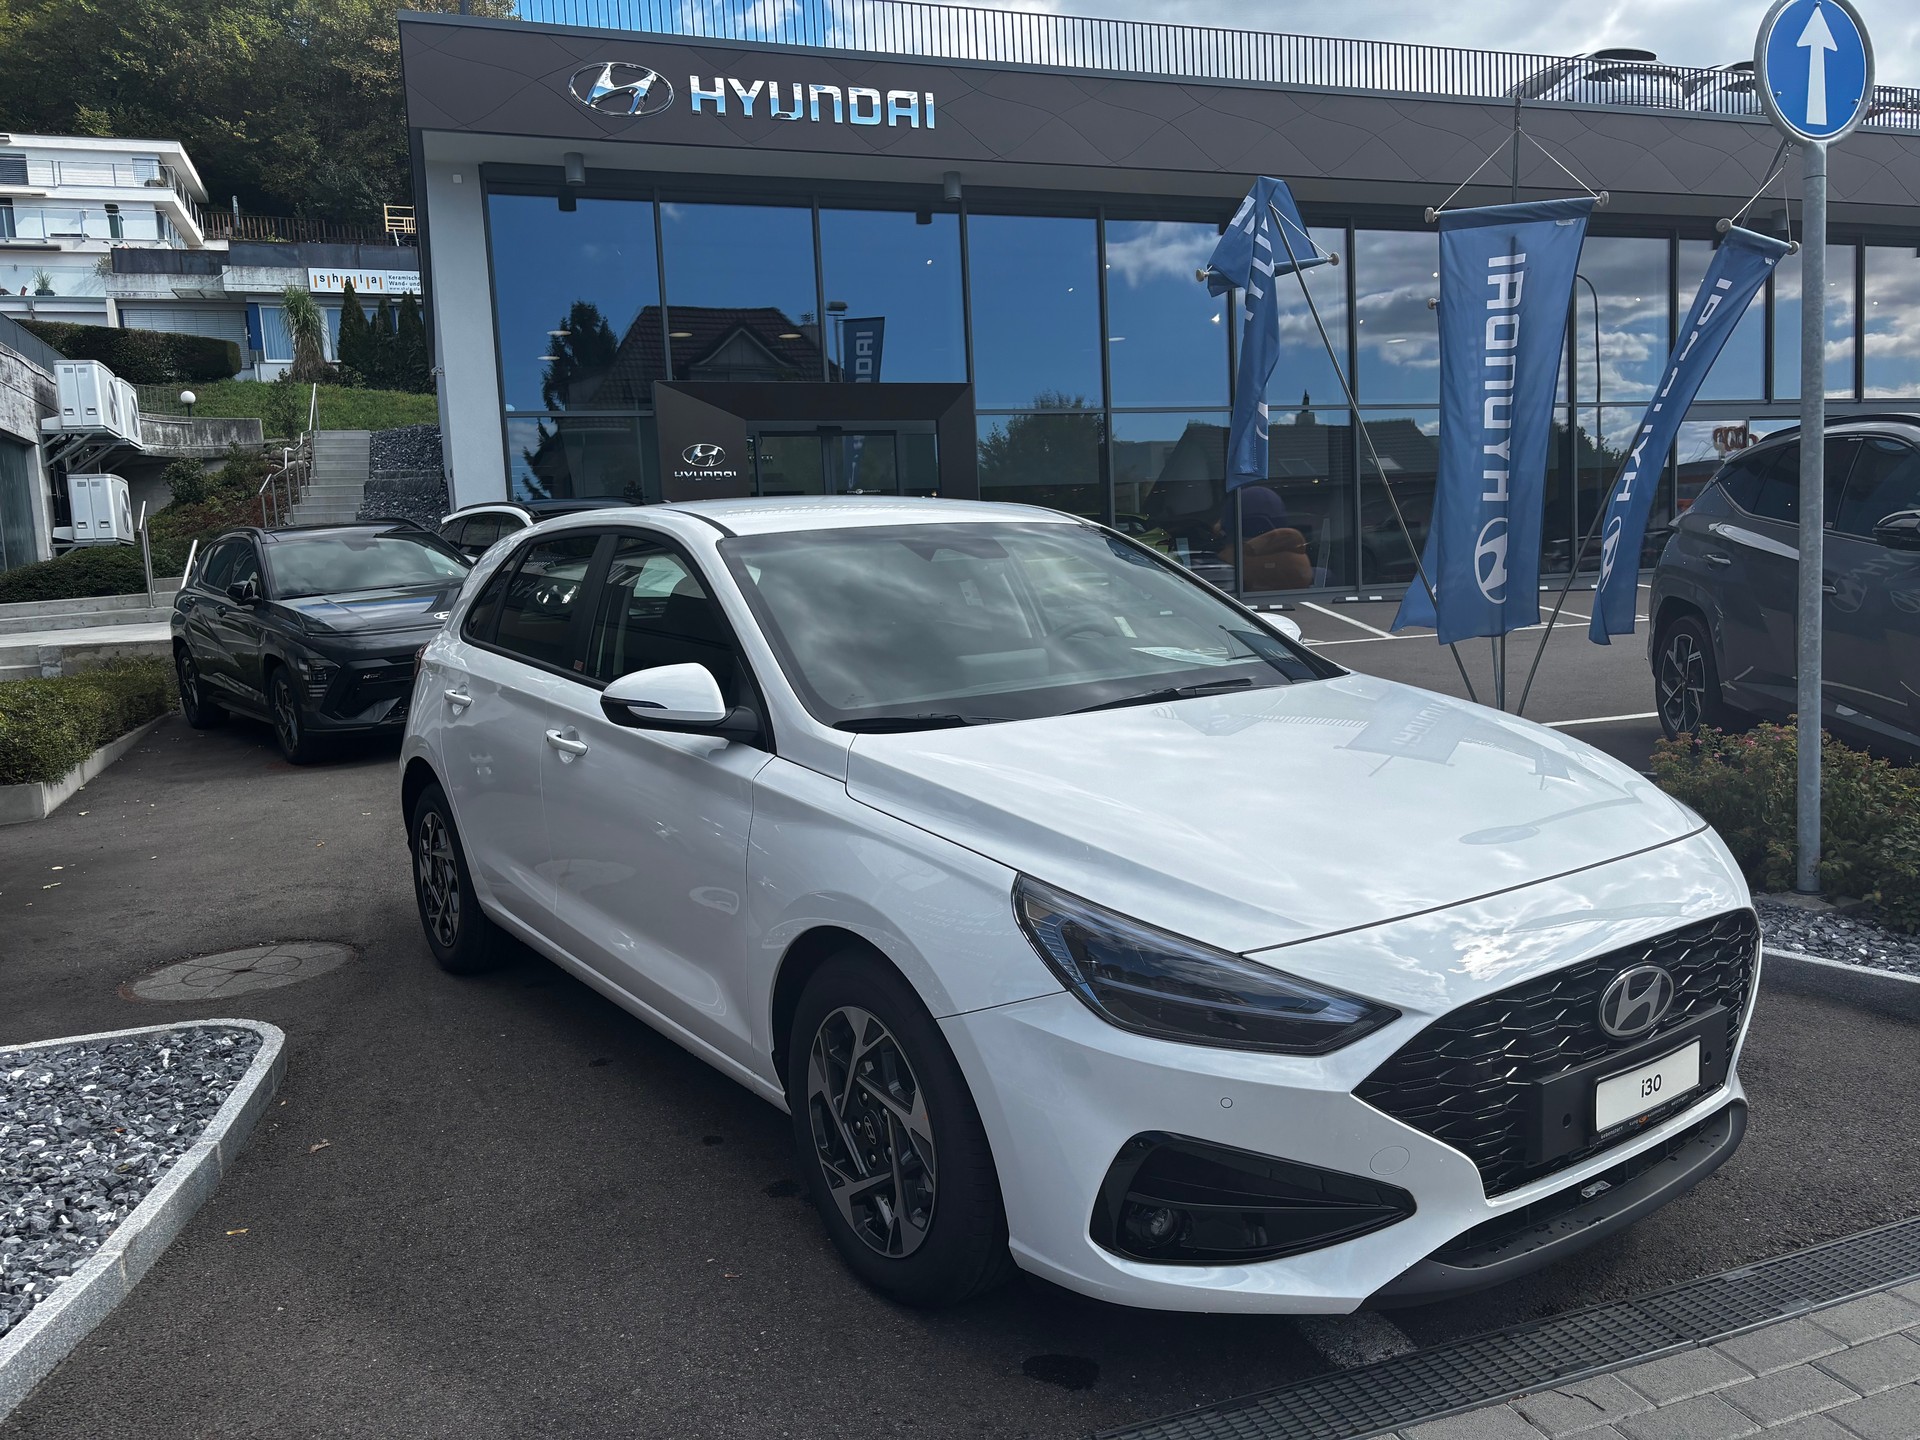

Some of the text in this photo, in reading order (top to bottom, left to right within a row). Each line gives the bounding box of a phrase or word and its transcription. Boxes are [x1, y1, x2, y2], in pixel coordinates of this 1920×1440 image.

[689, 74, 935, 129] HYUNDAI
[319, 273, 377, 284] shala
[855, 331, 874, 383] DAI
[674, 470, 737, 481] HYUNDAI
[1641, 1073, 1662, 1098] i30
